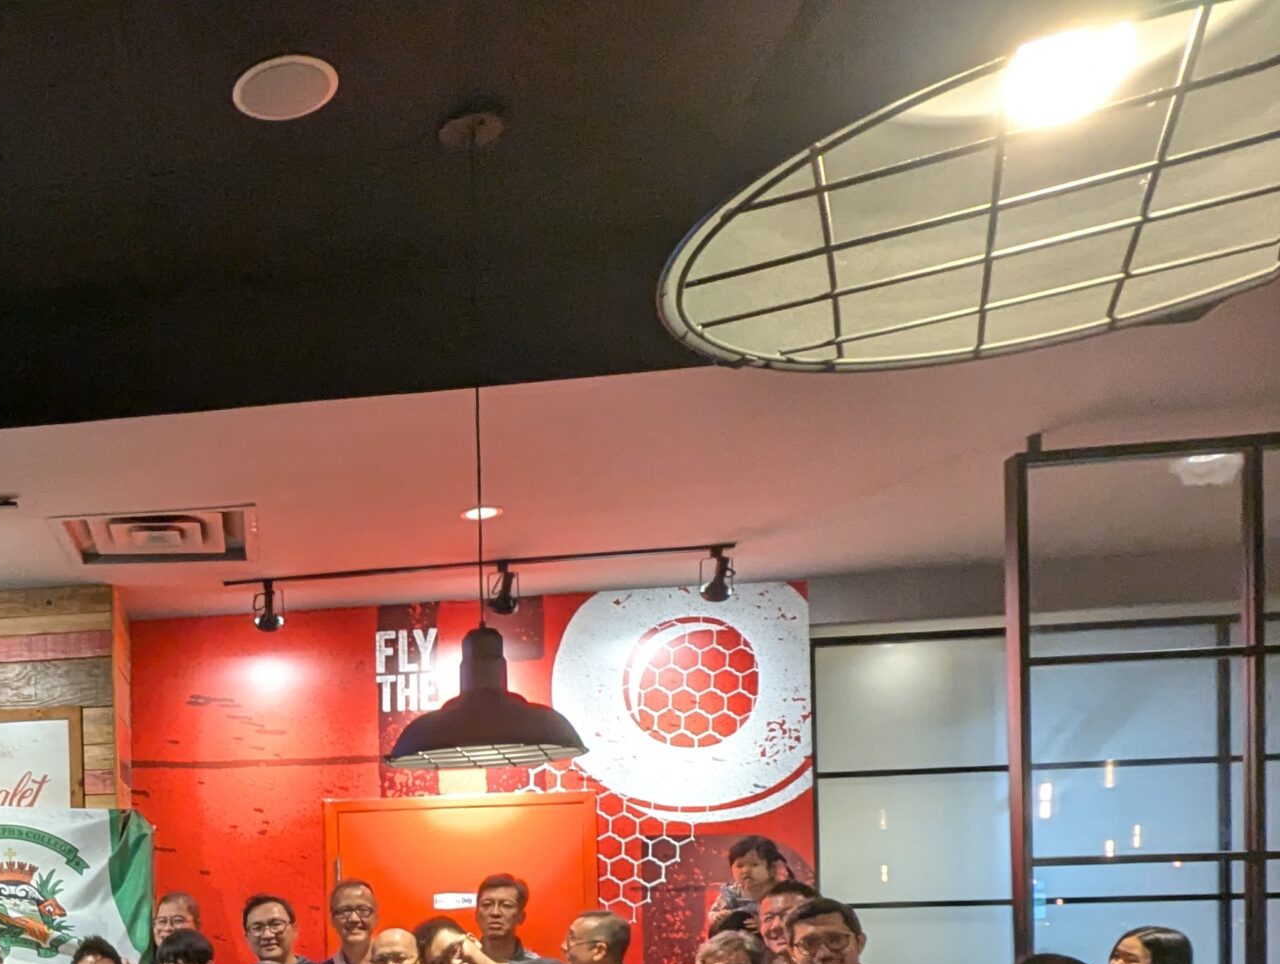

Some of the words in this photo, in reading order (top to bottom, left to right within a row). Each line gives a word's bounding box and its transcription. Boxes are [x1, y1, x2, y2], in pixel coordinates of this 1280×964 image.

[375, 628, 438, 674] FLY
[375, 674, 439, 713] THE
[25, 829, 76, 855] COLLEGE
